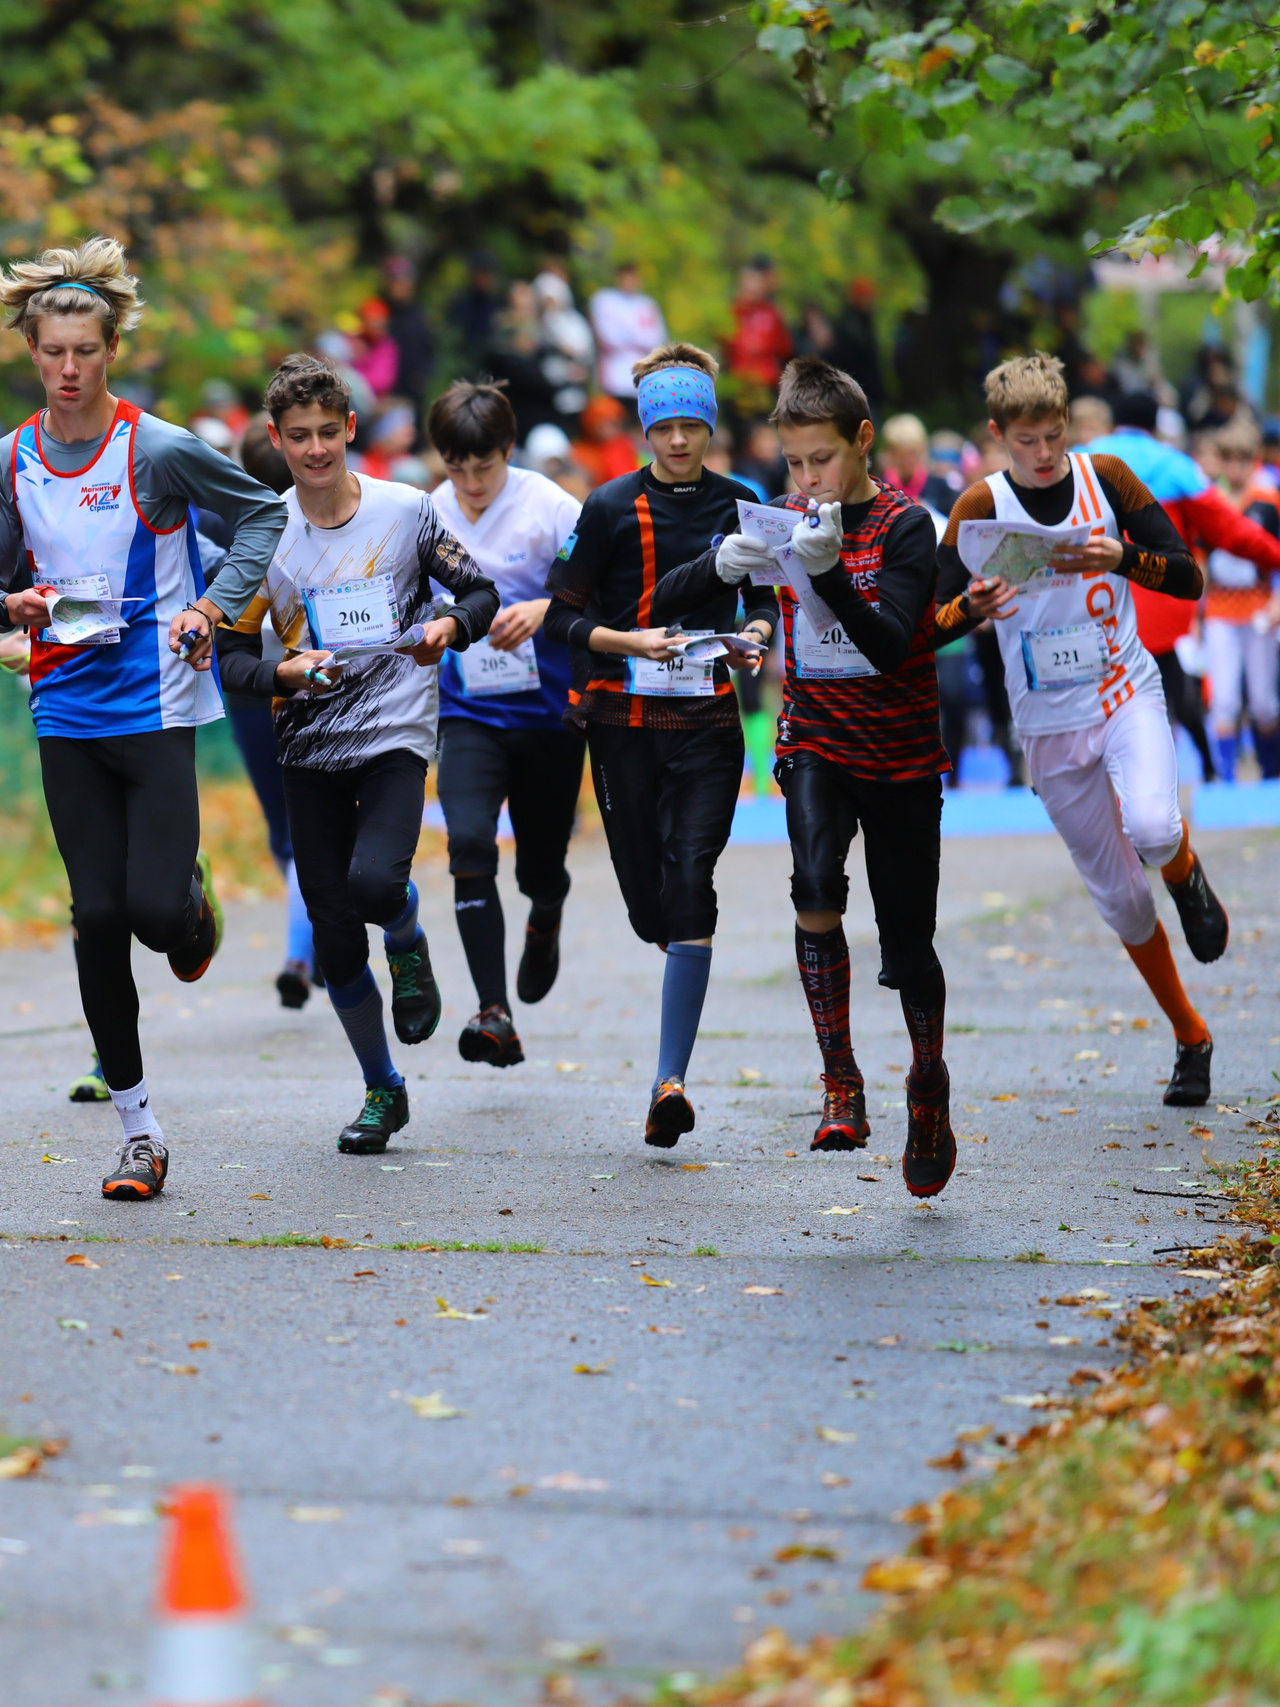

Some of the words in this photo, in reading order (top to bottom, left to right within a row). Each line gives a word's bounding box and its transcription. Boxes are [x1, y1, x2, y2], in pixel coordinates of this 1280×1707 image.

[338, 607, 371, 626] 206
[480, 656, 508, 672] 205
[656, 656, 684, 672] 204
[1052, 650, 1080, 667] 221
[804, 940, 820, 990] WEST
[812, 1000, 832, 1050] NORD
